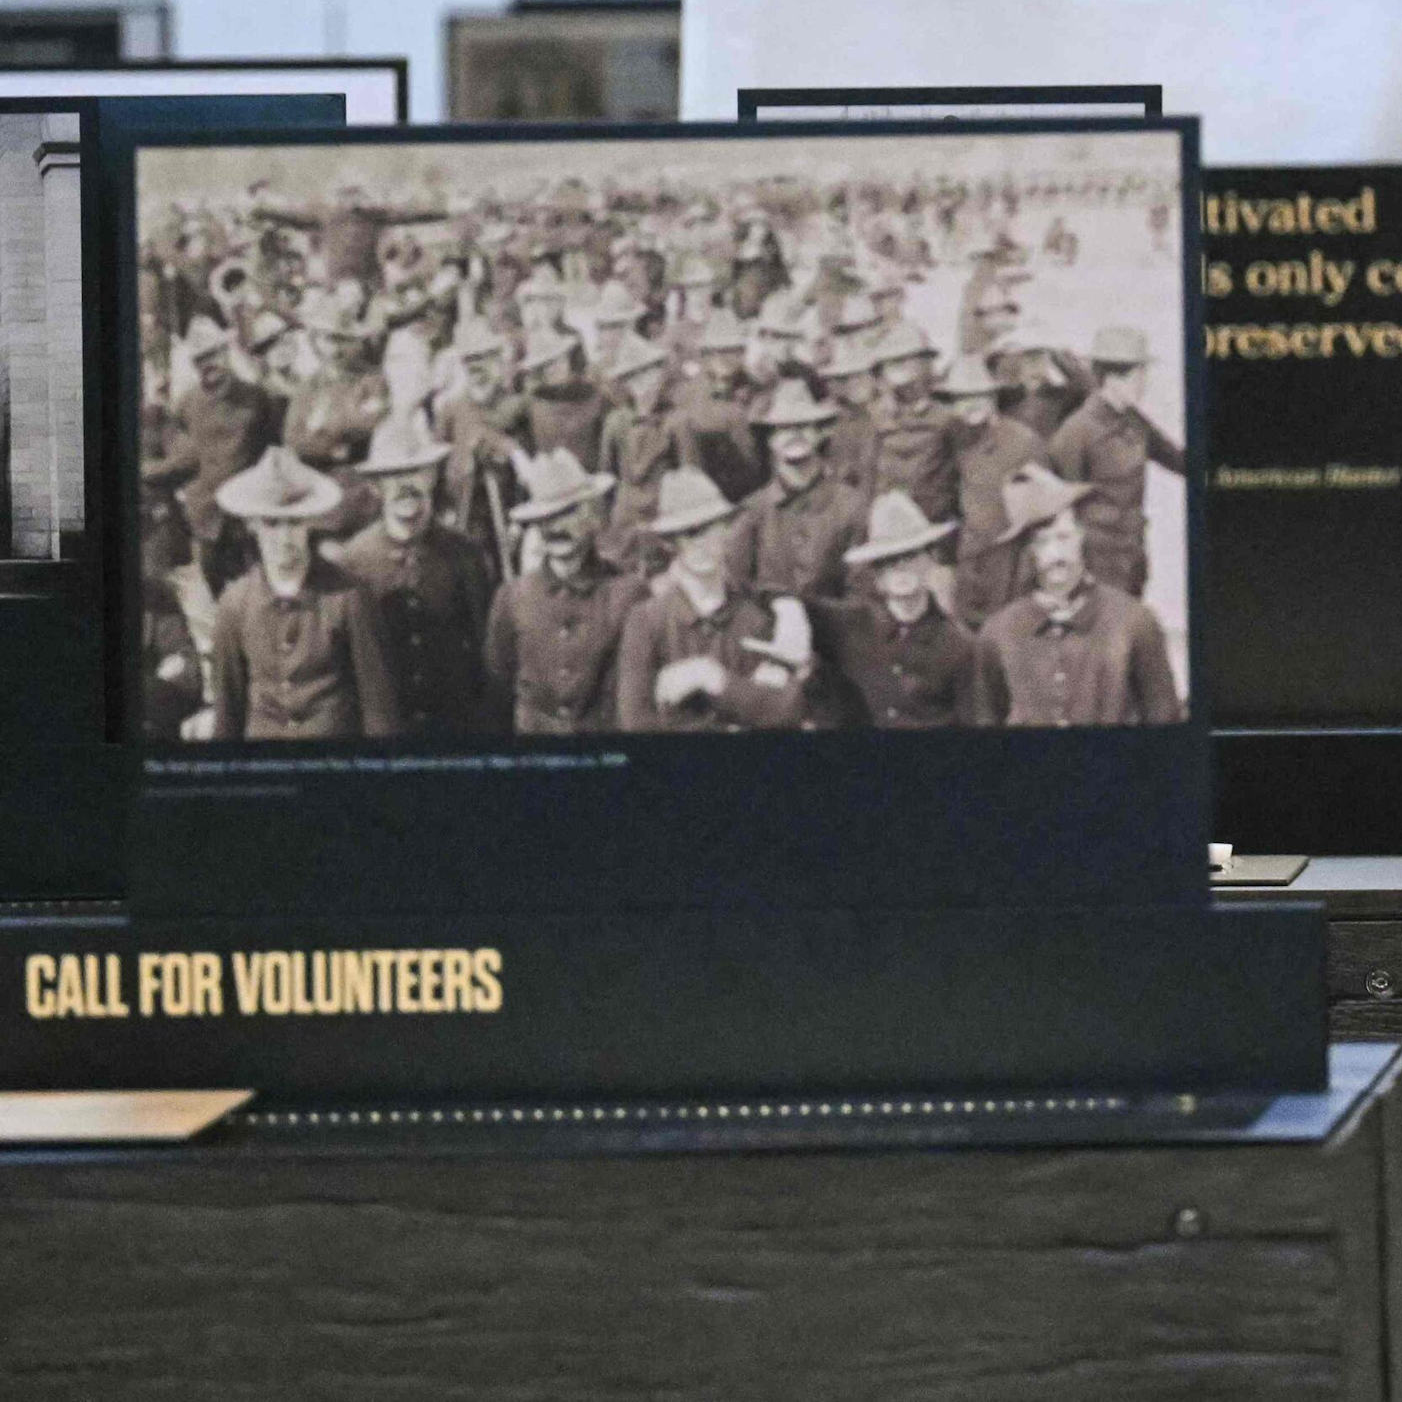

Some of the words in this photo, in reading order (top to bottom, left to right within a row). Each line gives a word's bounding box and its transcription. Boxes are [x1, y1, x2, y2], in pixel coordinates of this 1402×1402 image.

[1200, 186, 1376, 234] tivated
[1245, 249, 1353, 305] only
[25, 954, 128, 1018] CALL
[139, 952, 223, 1016] FOR
[232, 948, 503, 1015] VOLUNTEERS
